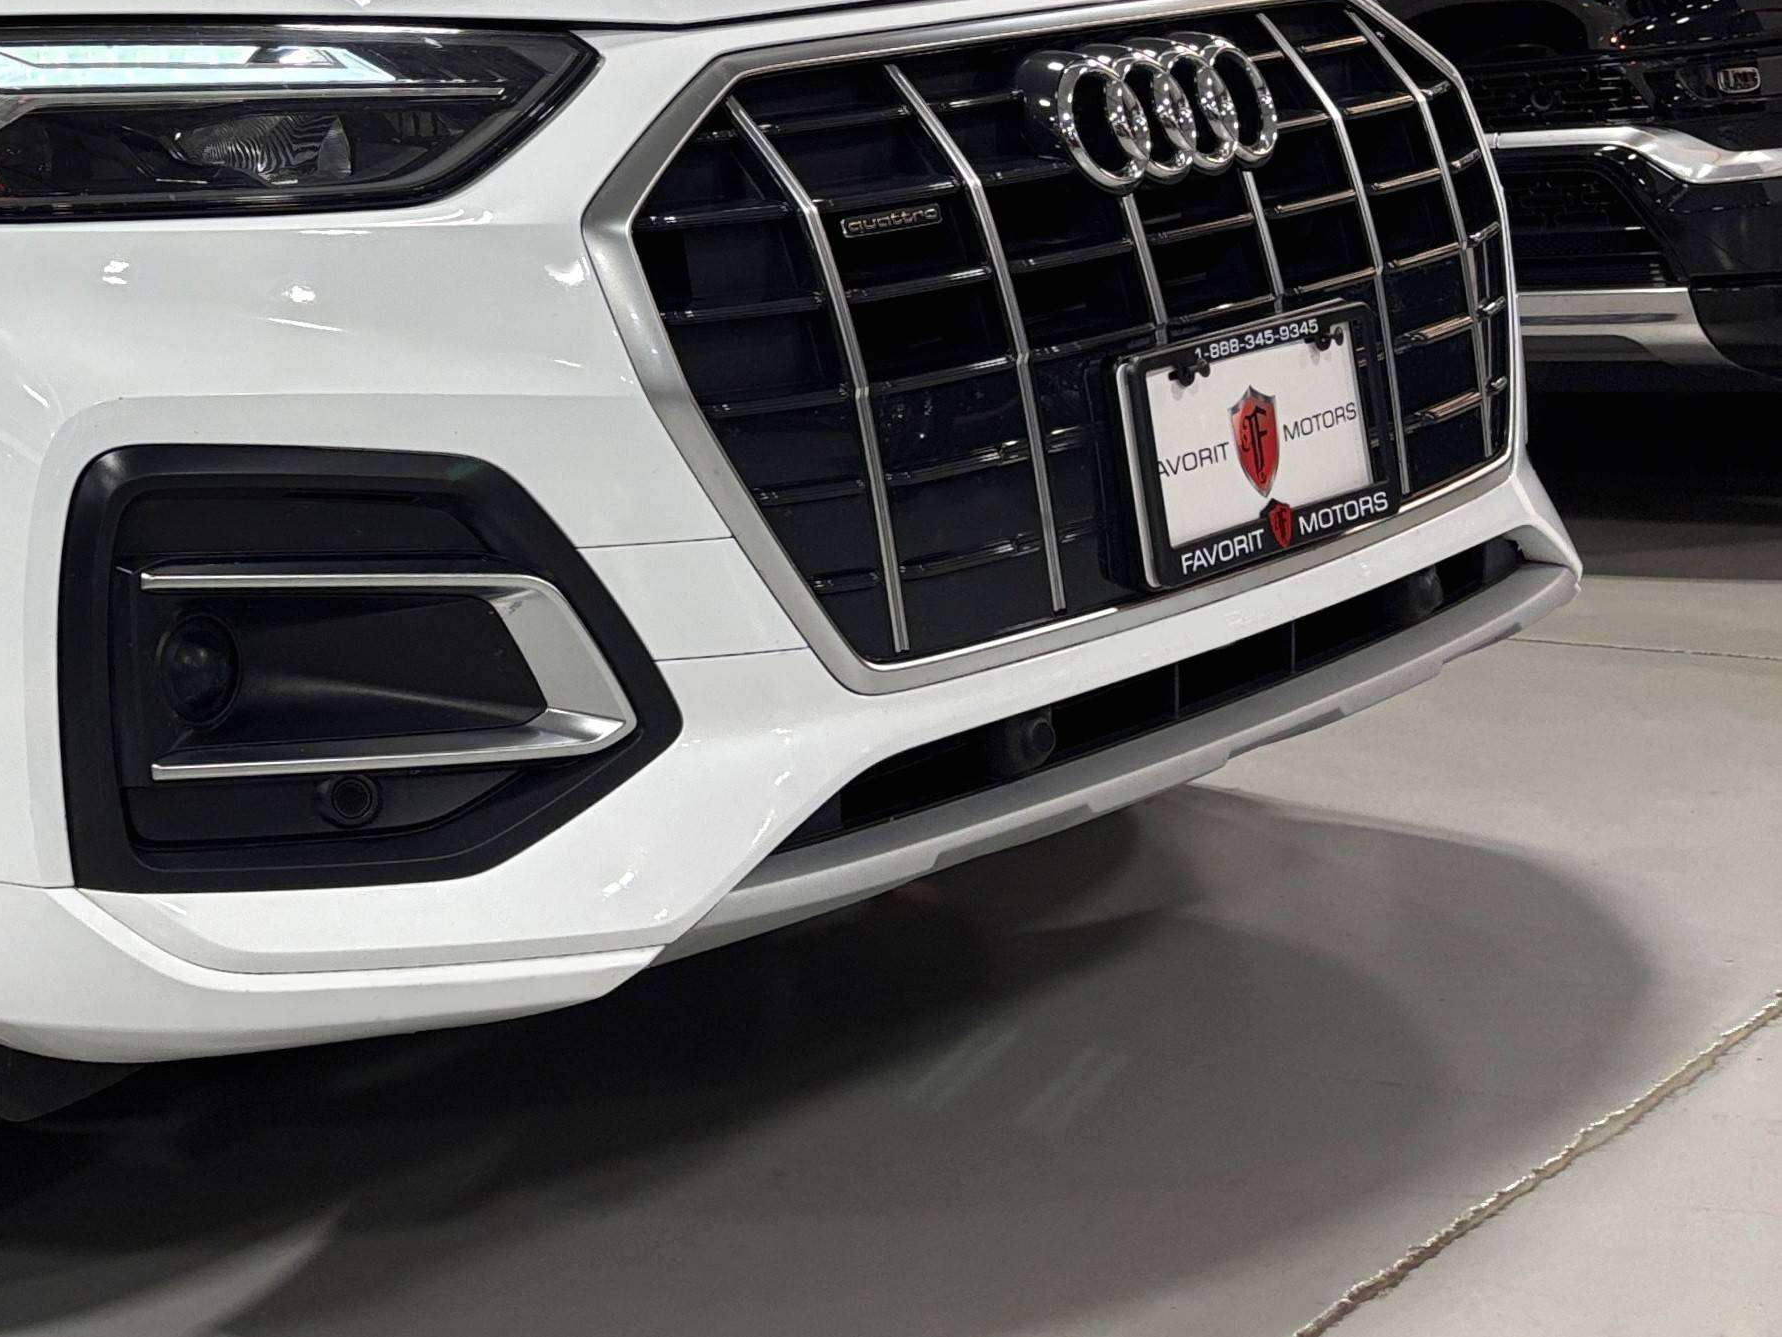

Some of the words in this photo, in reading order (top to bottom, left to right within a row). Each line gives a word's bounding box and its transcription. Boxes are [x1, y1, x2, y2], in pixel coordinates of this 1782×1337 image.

[847, 208, 937, 233] quattro
[1194, 318, 1319, 359] 1-888-345-9345
[1156, 442, 1230, 479] AVORIT
[1282, 402, 1358, 442] MOTORS
[1181, 528, 1265, 574] FAVORIT
[1298, 491, 1389, 536] MOTORS
